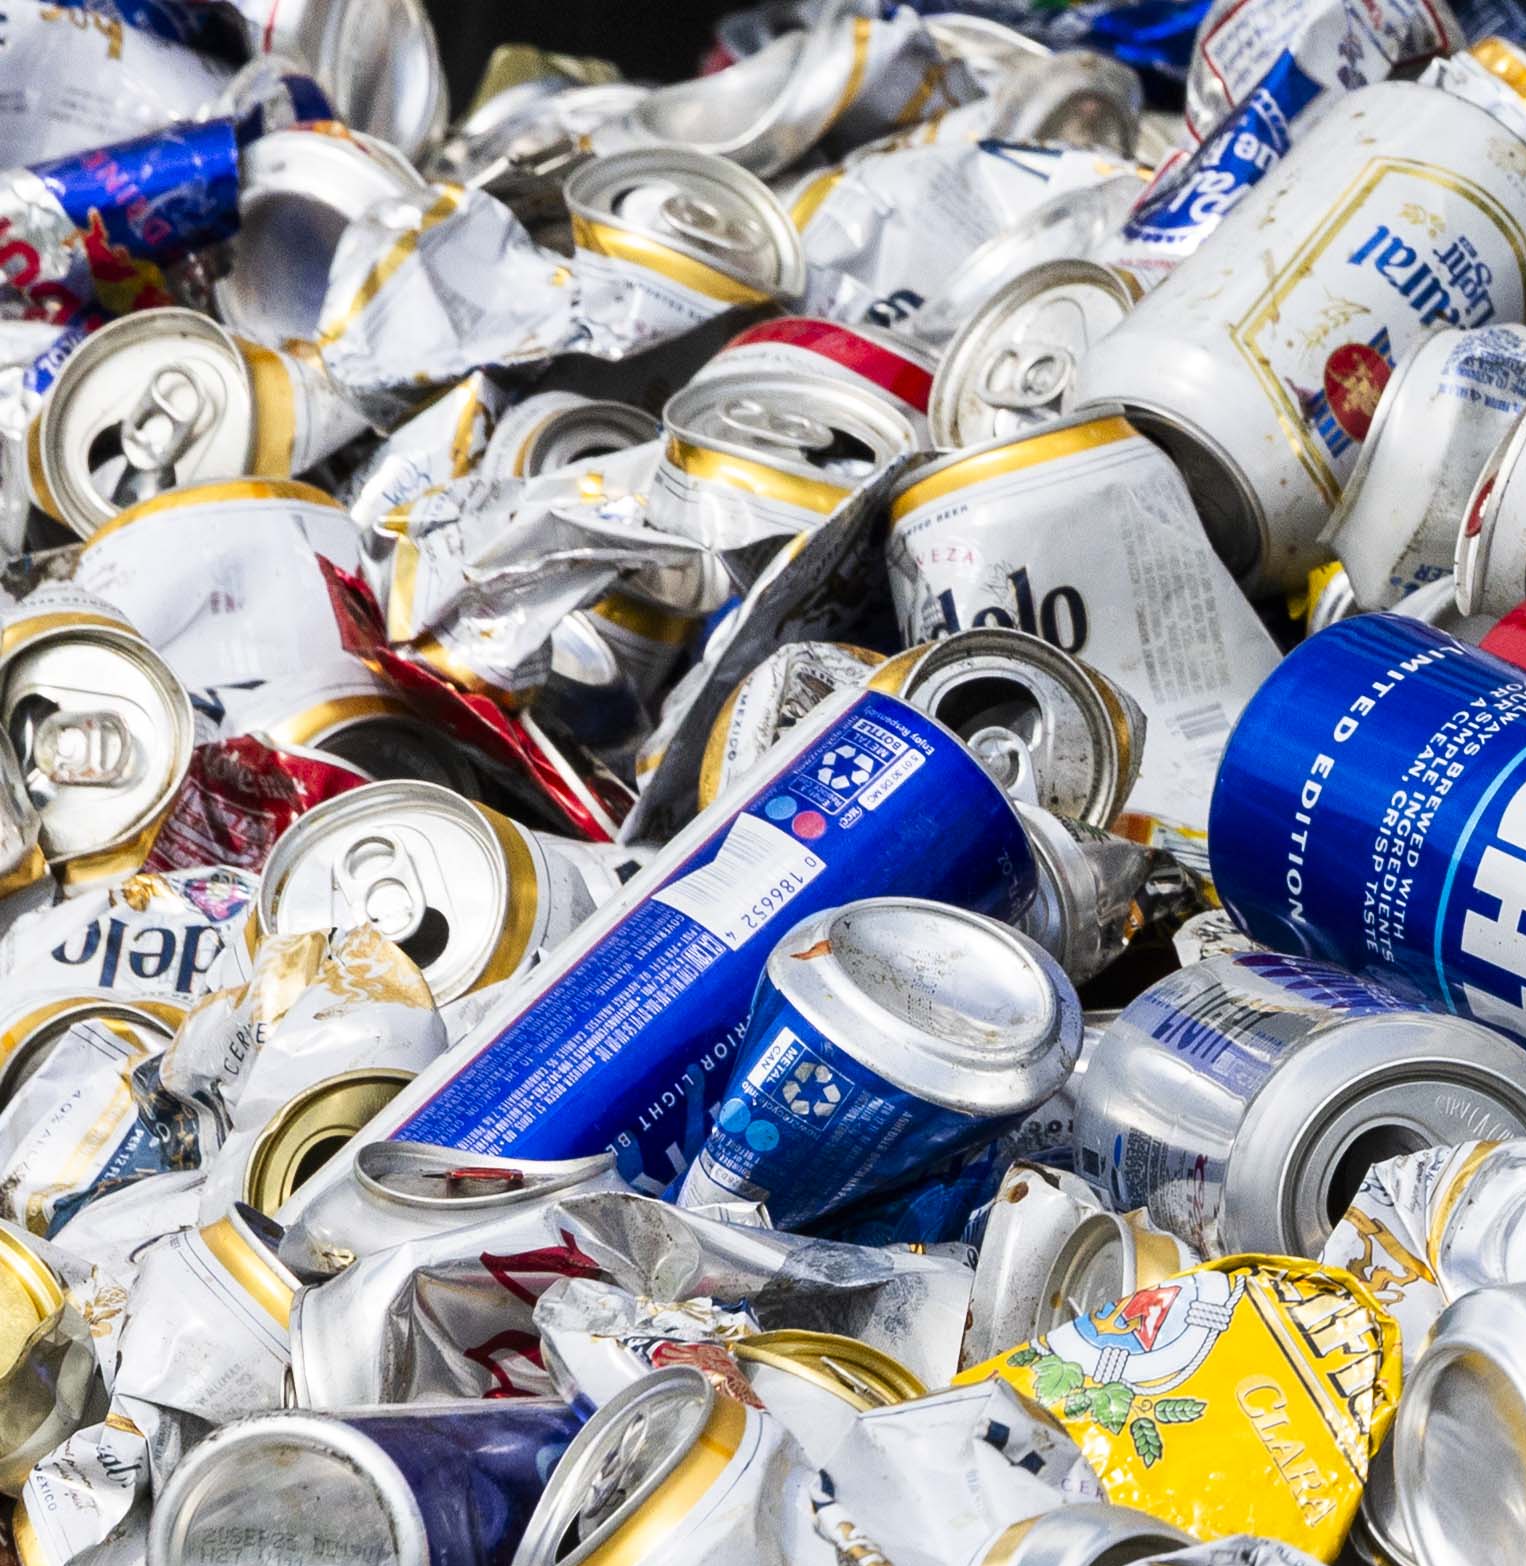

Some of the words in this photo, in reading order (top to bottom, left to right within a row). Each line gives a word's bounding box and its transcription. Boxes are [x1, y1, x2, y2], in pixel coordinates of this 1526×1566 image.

[1334, 646, 1464, 743] LIMITED
[851, 731, 891, 760] METAL
[857, 719, 903, 751] BOTTLE
[908, 729, 936, 757] Enjoy
[1402, 712, 1469, 782] CLEAN,
[1423, 711, 1488, 787] SIMPLE
[1286, 753, 1335, 924] EDITION
[1373, 789, 1407, 873] CRISP
[1406, 763, 1465, 868] BREWED
[740, 870, 805, 929] 186652
[1378, 790, 1425, 963] INGREDIENTS
[1398, 878, 1414, 940] WITH
[633, 912, 685, 962] GOVERNMENT
[1363, 880, 1379, 953] TASTE
[762, 1046, 782, 1070] CAN
[766, 1046, 799, 1084] METAL
[639, 1074, 696, 1132] LIGHT
[1235, 1375, 1337, 1529] CLARA
